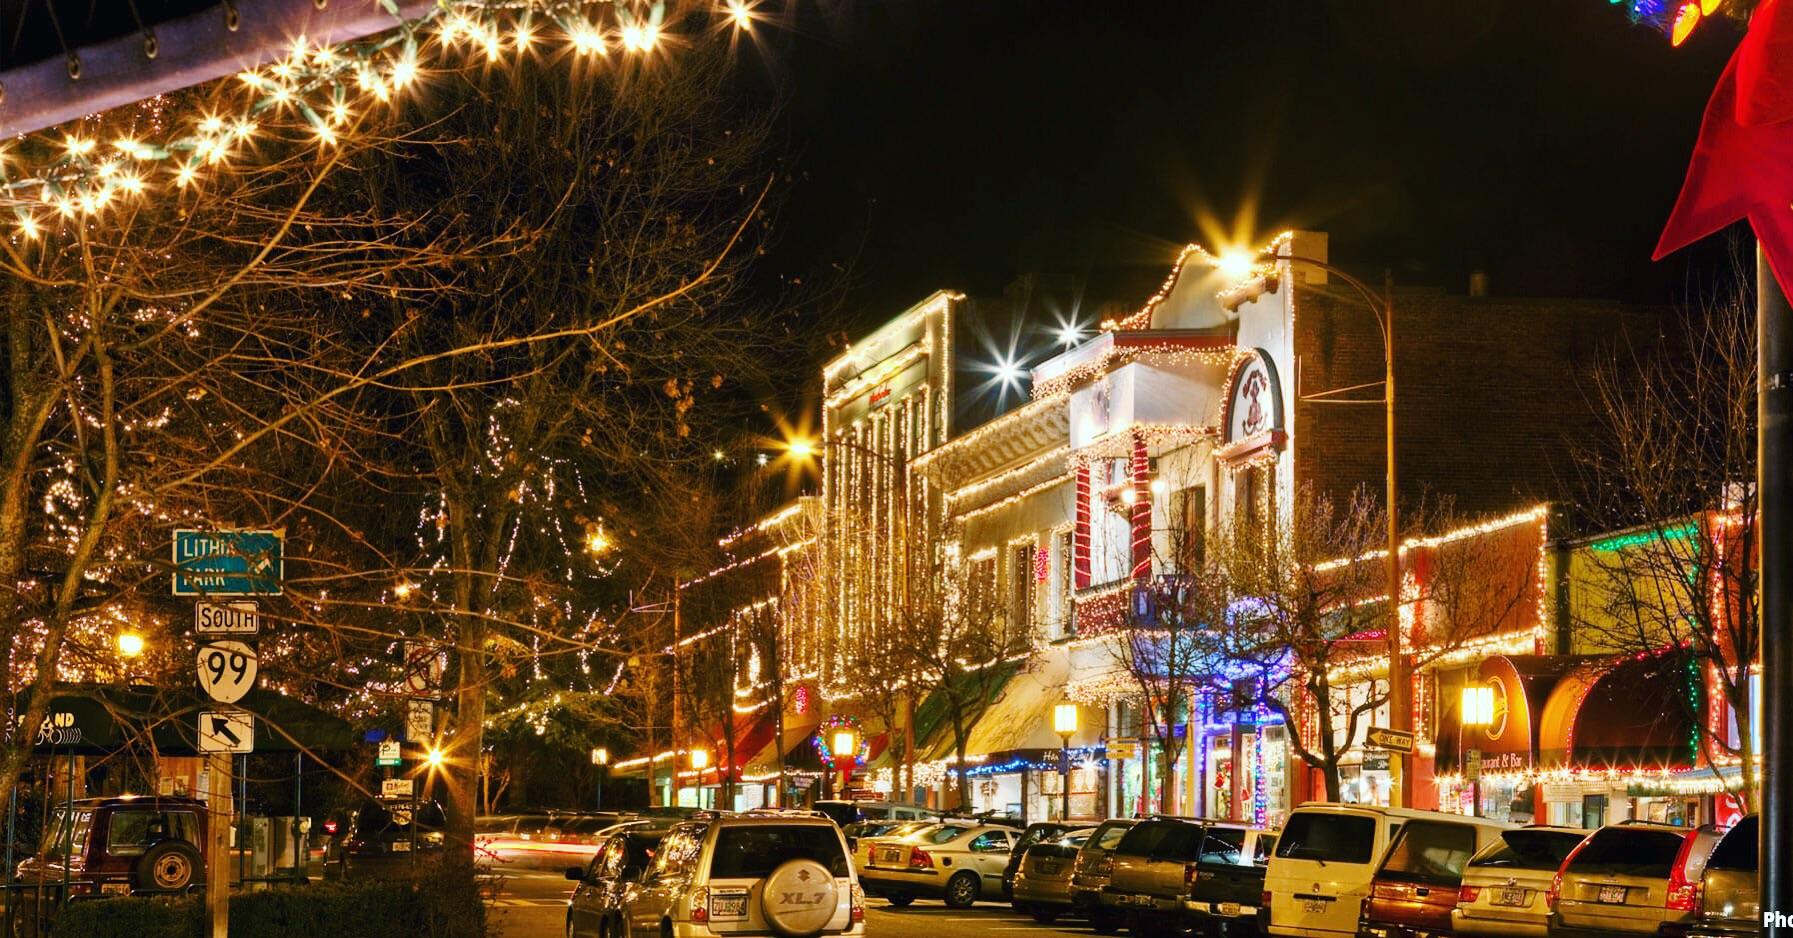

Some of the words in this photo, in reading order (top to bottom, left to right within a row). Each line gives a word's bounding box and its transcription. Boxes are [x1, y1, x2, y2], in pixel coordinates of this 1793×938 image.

[200, 607, 255, 628] SOUTH
[207, 651, 248, 686] 99
[1379, 733, 1394, 745] ONE
[1396, 736, 1411, 746] WAY
[1510, 753, 1522, 767] Bar
